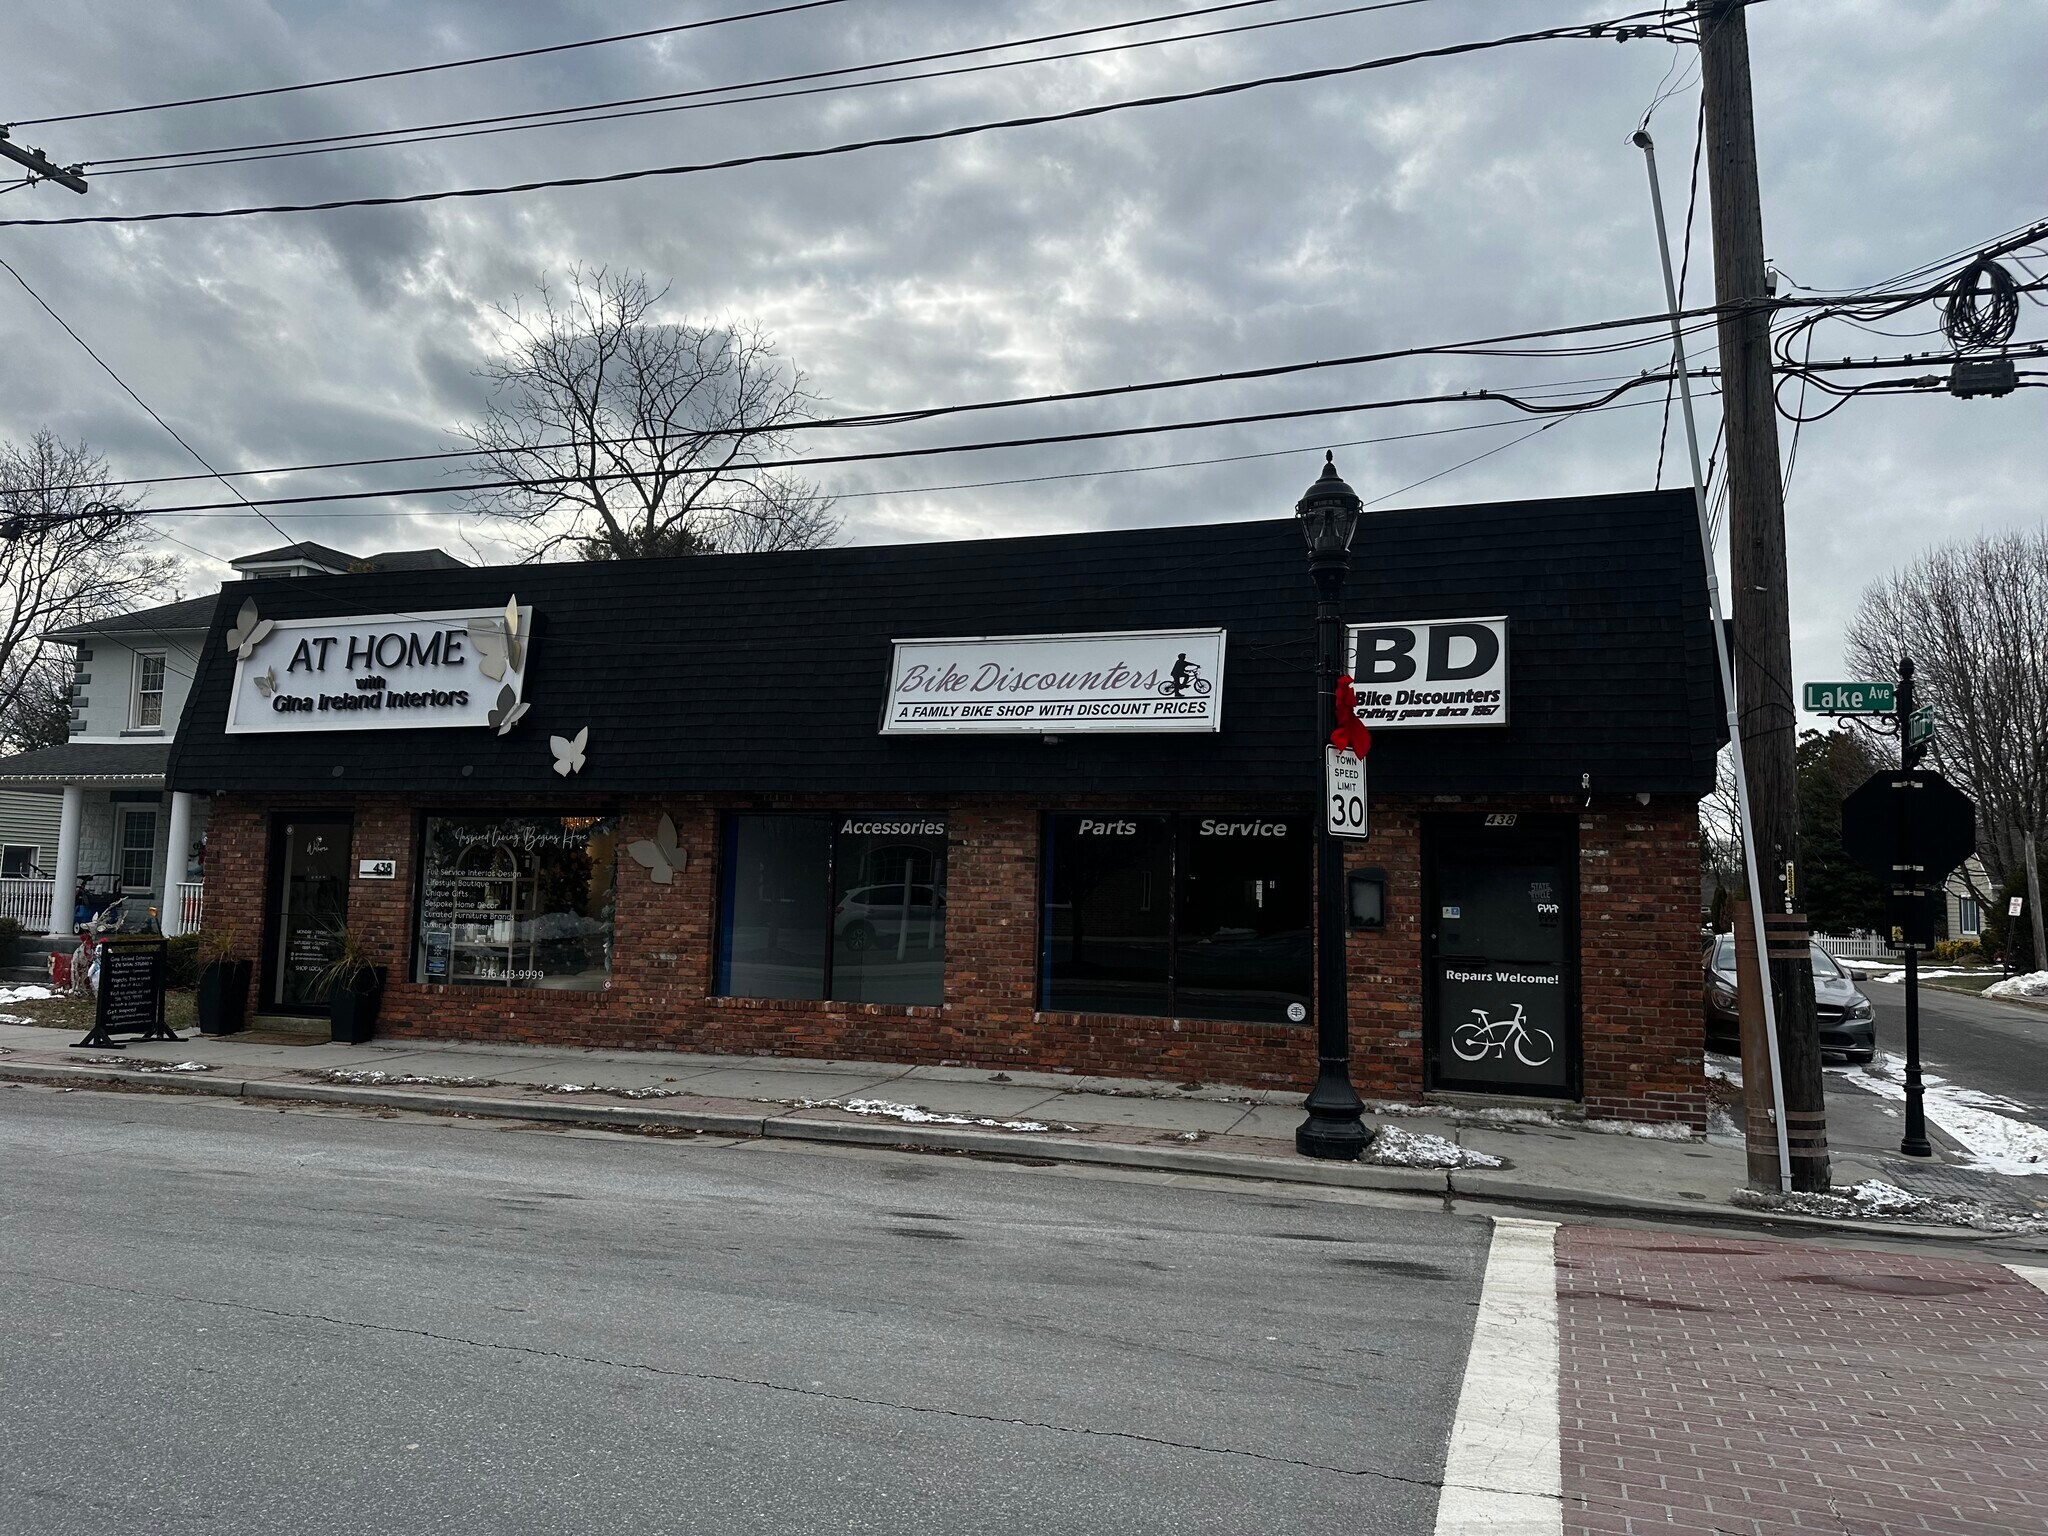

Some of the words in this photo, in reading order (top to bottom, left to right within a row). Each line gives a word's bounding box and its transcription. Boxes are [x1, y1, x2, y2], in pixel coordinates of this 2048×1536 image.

[286, 636, 338, 672] AT
[344, 629, 468, 670] HOME
[1353, 623, 1500, 684] BD
[355, 674, 387, 691] with
[895, 662, 968, 693] Bike
[968, 660, 1162, 693] Discounters
[272, 694, 314, 713] Gina
[317, 691, 383, 712] Ireland
[385, 689, 469, 709] Interiors
[1355, 691, 1393, 706] Bike
[1395, 689, 1501, 706] Discounters
[1807, 686, 1864, 709] Lake
[1868, 686, 1890, 700] Ave
[899, 706, 909, 718] A
[911, 706, 960, 718] FAMILY
[961, 705, 994, 717] BIKE
[996, 704, 1034, 717] SHOP
[1038, 703, 1075, 717] WITH
[1076, 702, 1151, 716] DISCOUNT
[1153, 701, 1207, 715] PRICES
[1335, 755, 1358, 766] TOWN
[1334, 768, 1359, 780] SPEED
[1337, 781, 1357, 792] LIMIT
[1331, 793, 1364, 828] 30
[840, 818, 945, 835] Accessories
[1078, 819, 1137, 835] Parts
[1199, 819, 1287, 837] Service
[1485, 814, 1515, 826] 438
[523, 826, 561, 851] Begins
[562, 826, 589, 849] Here
[373, 862, 392, 875] 438
[441, 868, 466, 876] Service
[497, 870, 522, 879] Design
[426, 879, 456, 888] Lifestyle
[458, 880, 490, 889] Boutique
[425, 890, 450, 898] Unique
[452, 889, 469, 898] Gifts
[424, 900, 453, 909] Bespoke
[455, 901, 475, 909] Home
[424, 911, 453, 919] Curated
[454, 911, 488, 920] Furniture
[489, 912, 515, 921] Brands
[1446, 969, 1493, 983] Repairs
[1495, 971, 1560, 984] Welcome!
